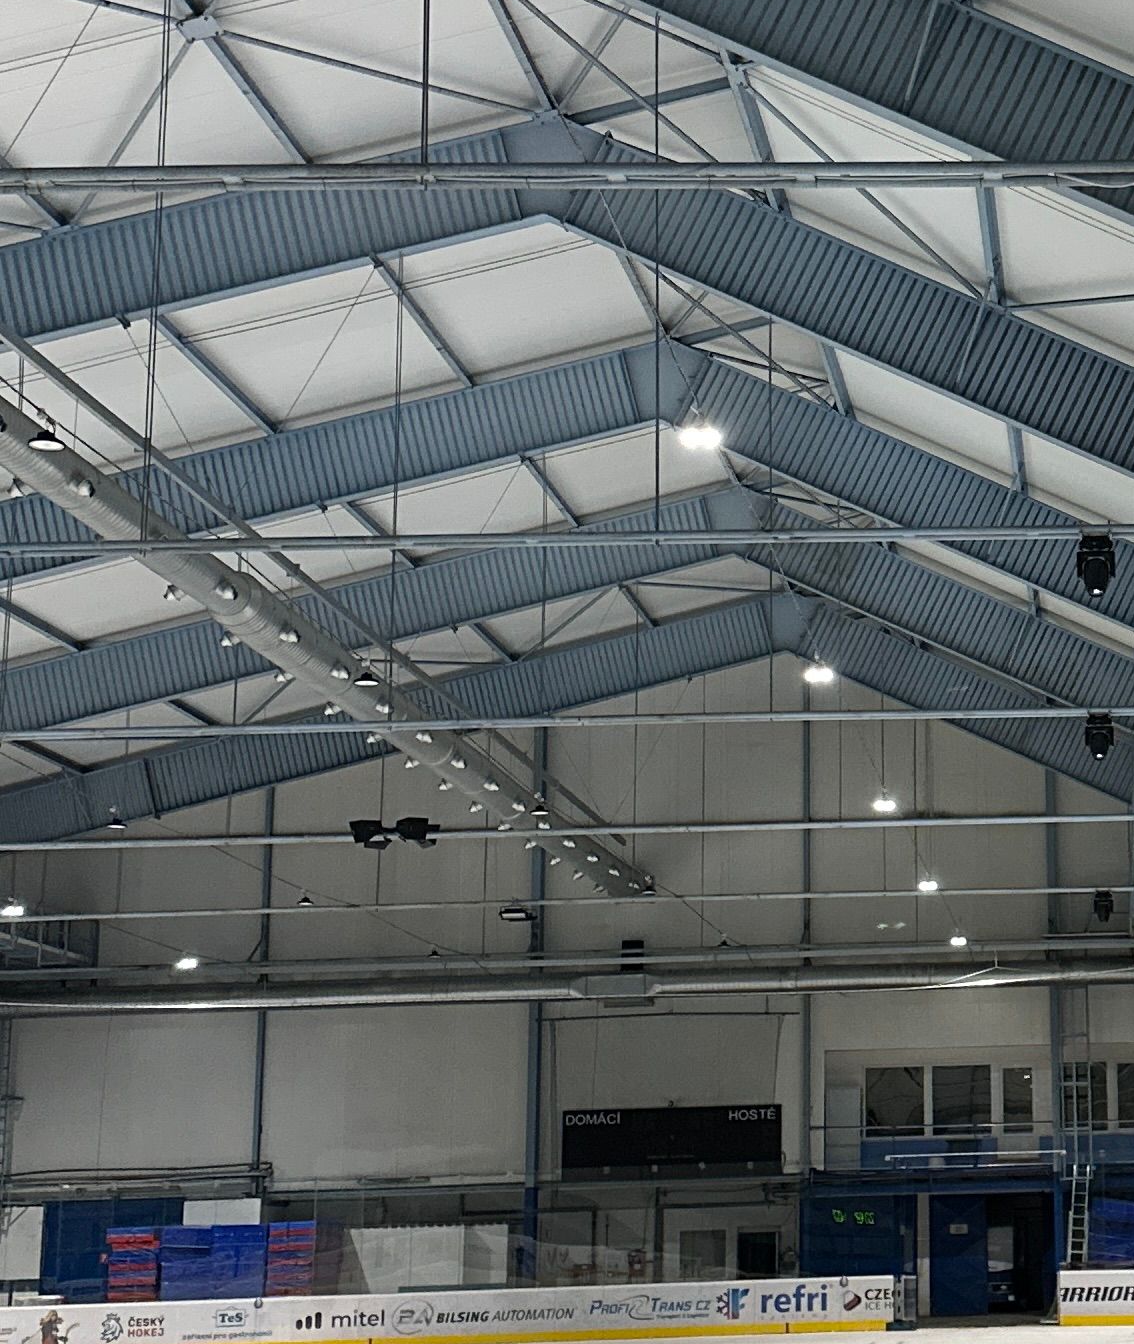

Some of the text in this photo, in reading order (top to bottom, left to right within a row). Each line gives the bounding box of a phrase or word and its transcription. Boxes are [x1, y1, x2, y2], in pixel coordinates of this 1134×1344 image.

[565, 1108, 777, 1126] DOMÁCÍ HOSTÉ
[695, 1299, 711, 1311] CZ
[761, 1284, 828, 1313] refri
[128, 1315, 165, 1327] ČESKÝ
[332, 1309, 385, 1328] mitel
[436, 1307, 575, 1324] BILSING AUTOMATION
[128, 1327, 164, 1338] HOKEJ
